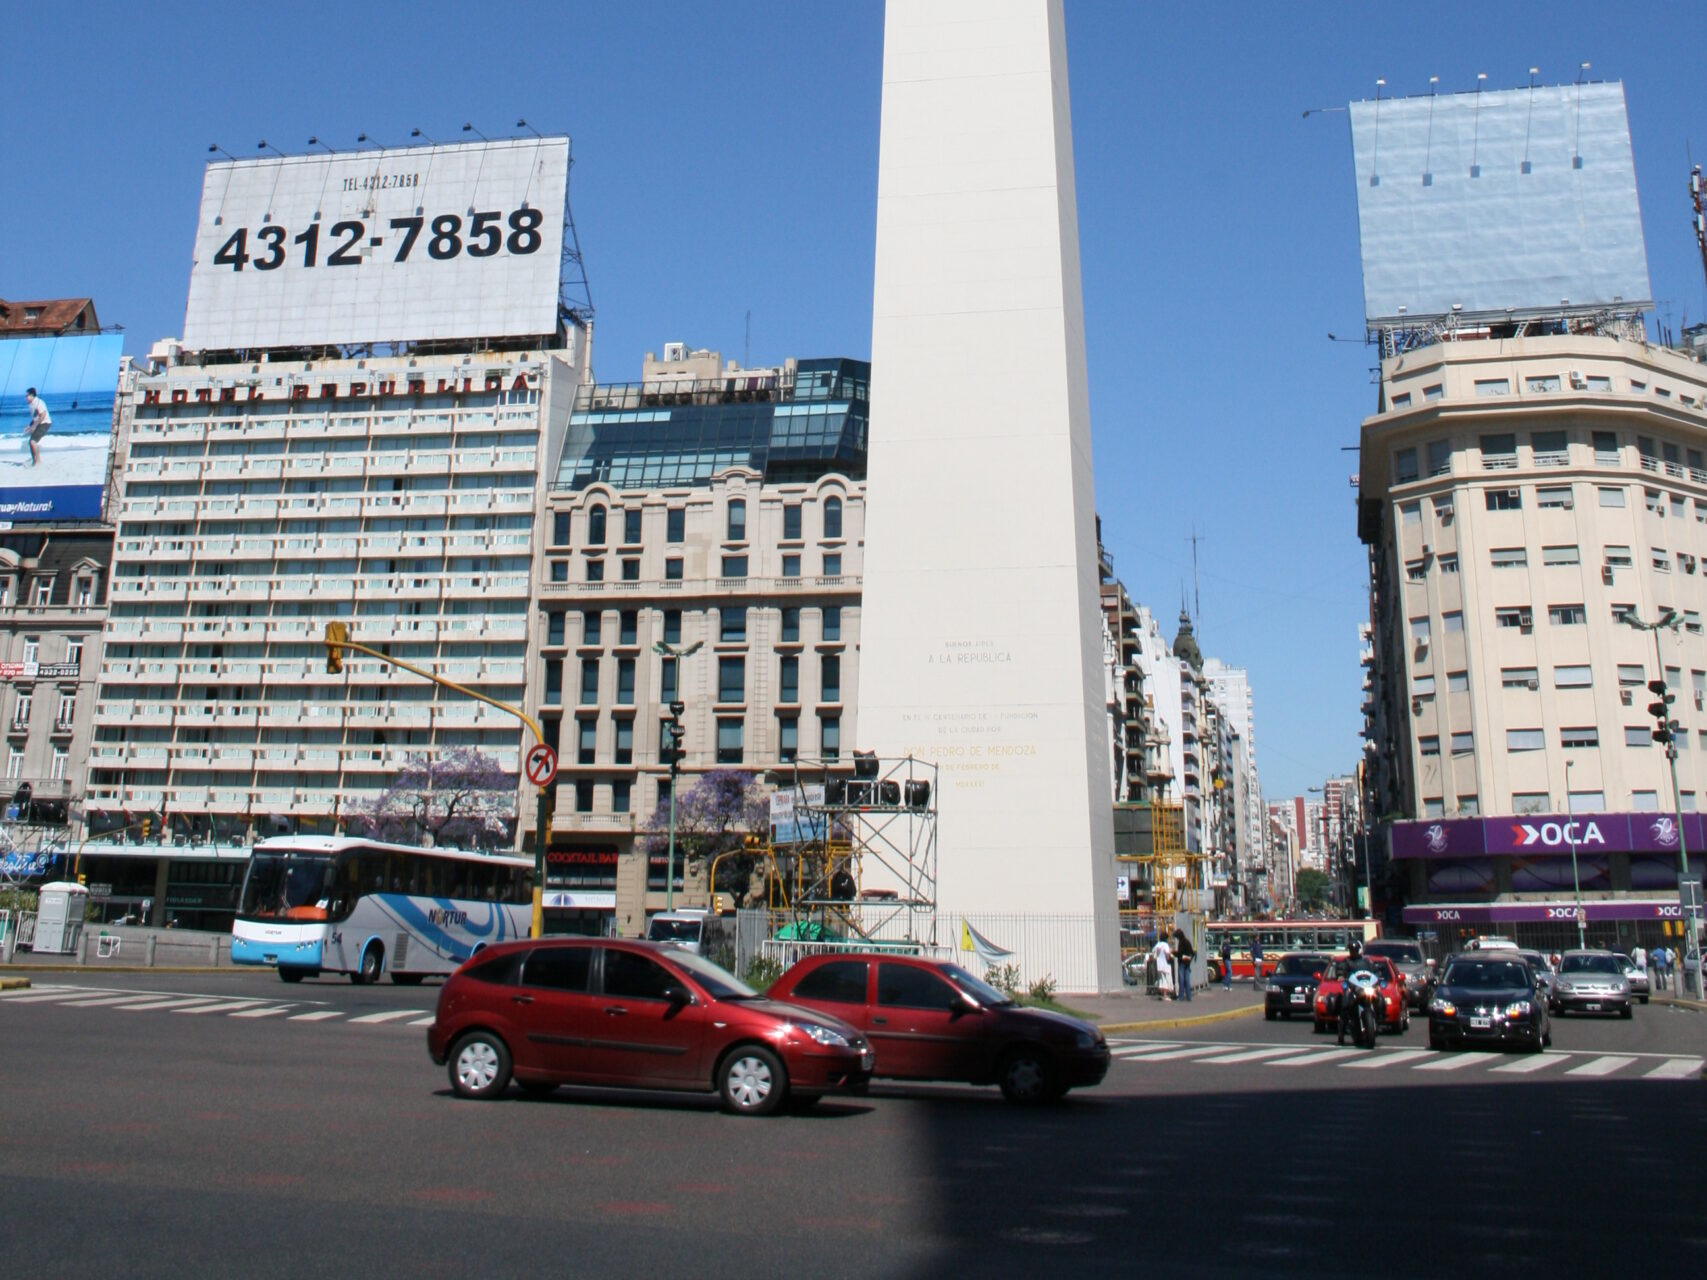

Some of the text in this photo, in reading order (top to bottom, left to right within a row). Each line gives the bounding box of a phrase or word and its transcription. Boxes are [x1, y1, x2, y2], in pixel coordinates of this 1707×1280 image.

[213, 208, 544, 272] 4312-7858
[143, 372, 529, 405] HOTEL REPUBLICA
[928, 652, 1012, 664] A LA REPUBLICA
[904, 745, 1036, 757] DON PEDRO DE MENDOZA
[1539, 821, 1606, 845] OCA
[547, 852, 618, 864] COCKTAIL BAR
[1442, 910, 1461, 920] OCA
[331, 933, 342, 945] 54
